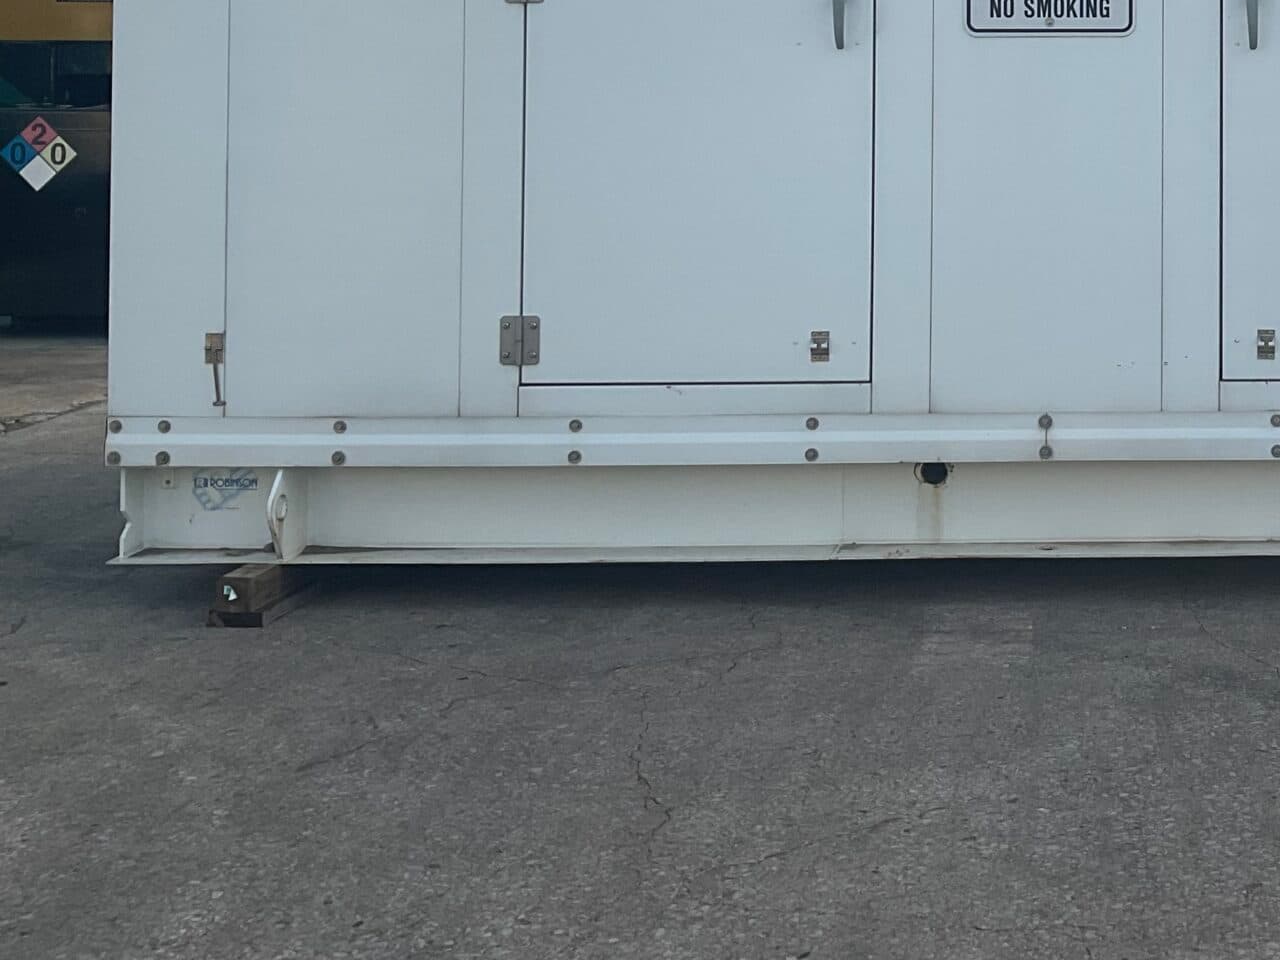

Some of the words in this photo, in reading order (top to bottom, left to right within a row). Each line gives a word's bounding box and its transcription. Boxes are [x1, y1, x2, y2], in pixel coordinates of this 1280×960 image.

[31, 123, 47, 146] 2
[9, 142, 26, 166] 0
[50, 142, 67, 166] 0
